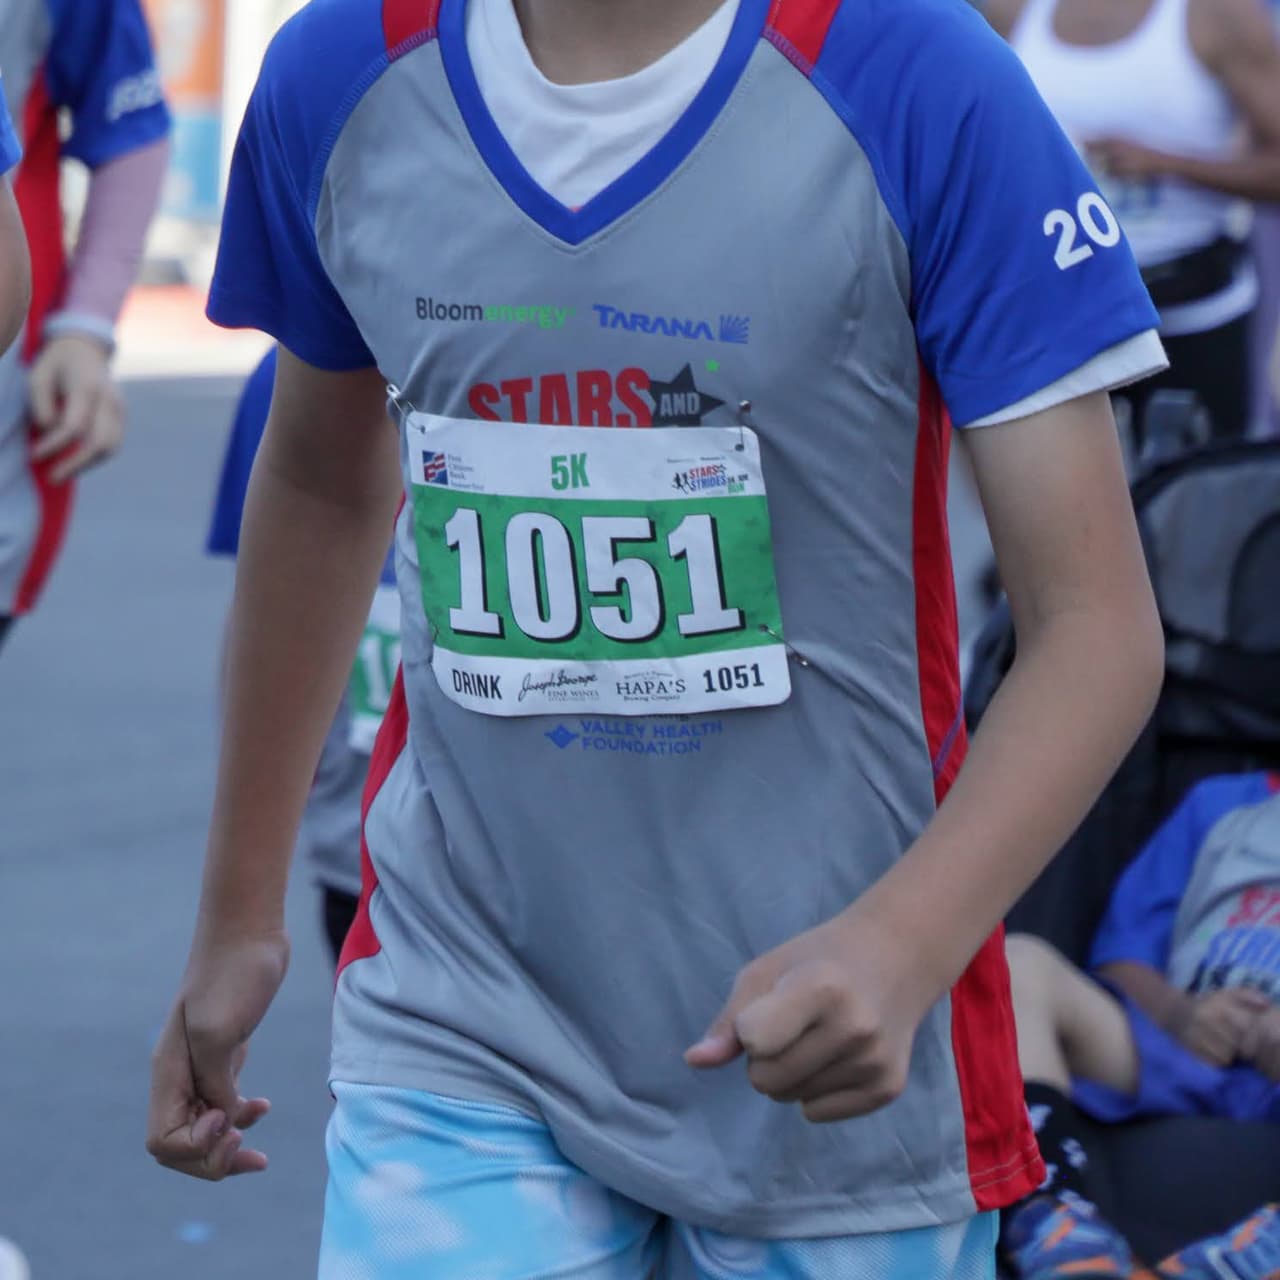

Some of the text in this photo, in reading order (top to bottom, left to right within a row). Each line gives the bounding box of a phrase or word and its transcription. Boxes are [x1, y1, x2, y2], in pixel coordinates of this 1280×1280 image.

[1043, 191, 1120, 271] 20
[592, 303, 715, 342] TARANA
[468, 368, 700, 427] STARS AND
[550, 452, 590, 492] 5K
[445, 507, 746, 644] 1051
[452, 667, 503, 700] DRINK
[615, 679, 687, 696] HAPA'S
[703, 663, 765, 693] 1051
[579, 719, 645, 738] VALLEY
[653, 719, 723, 738] HEALTH
[581, 736, 701, 755] FOUNDATION
